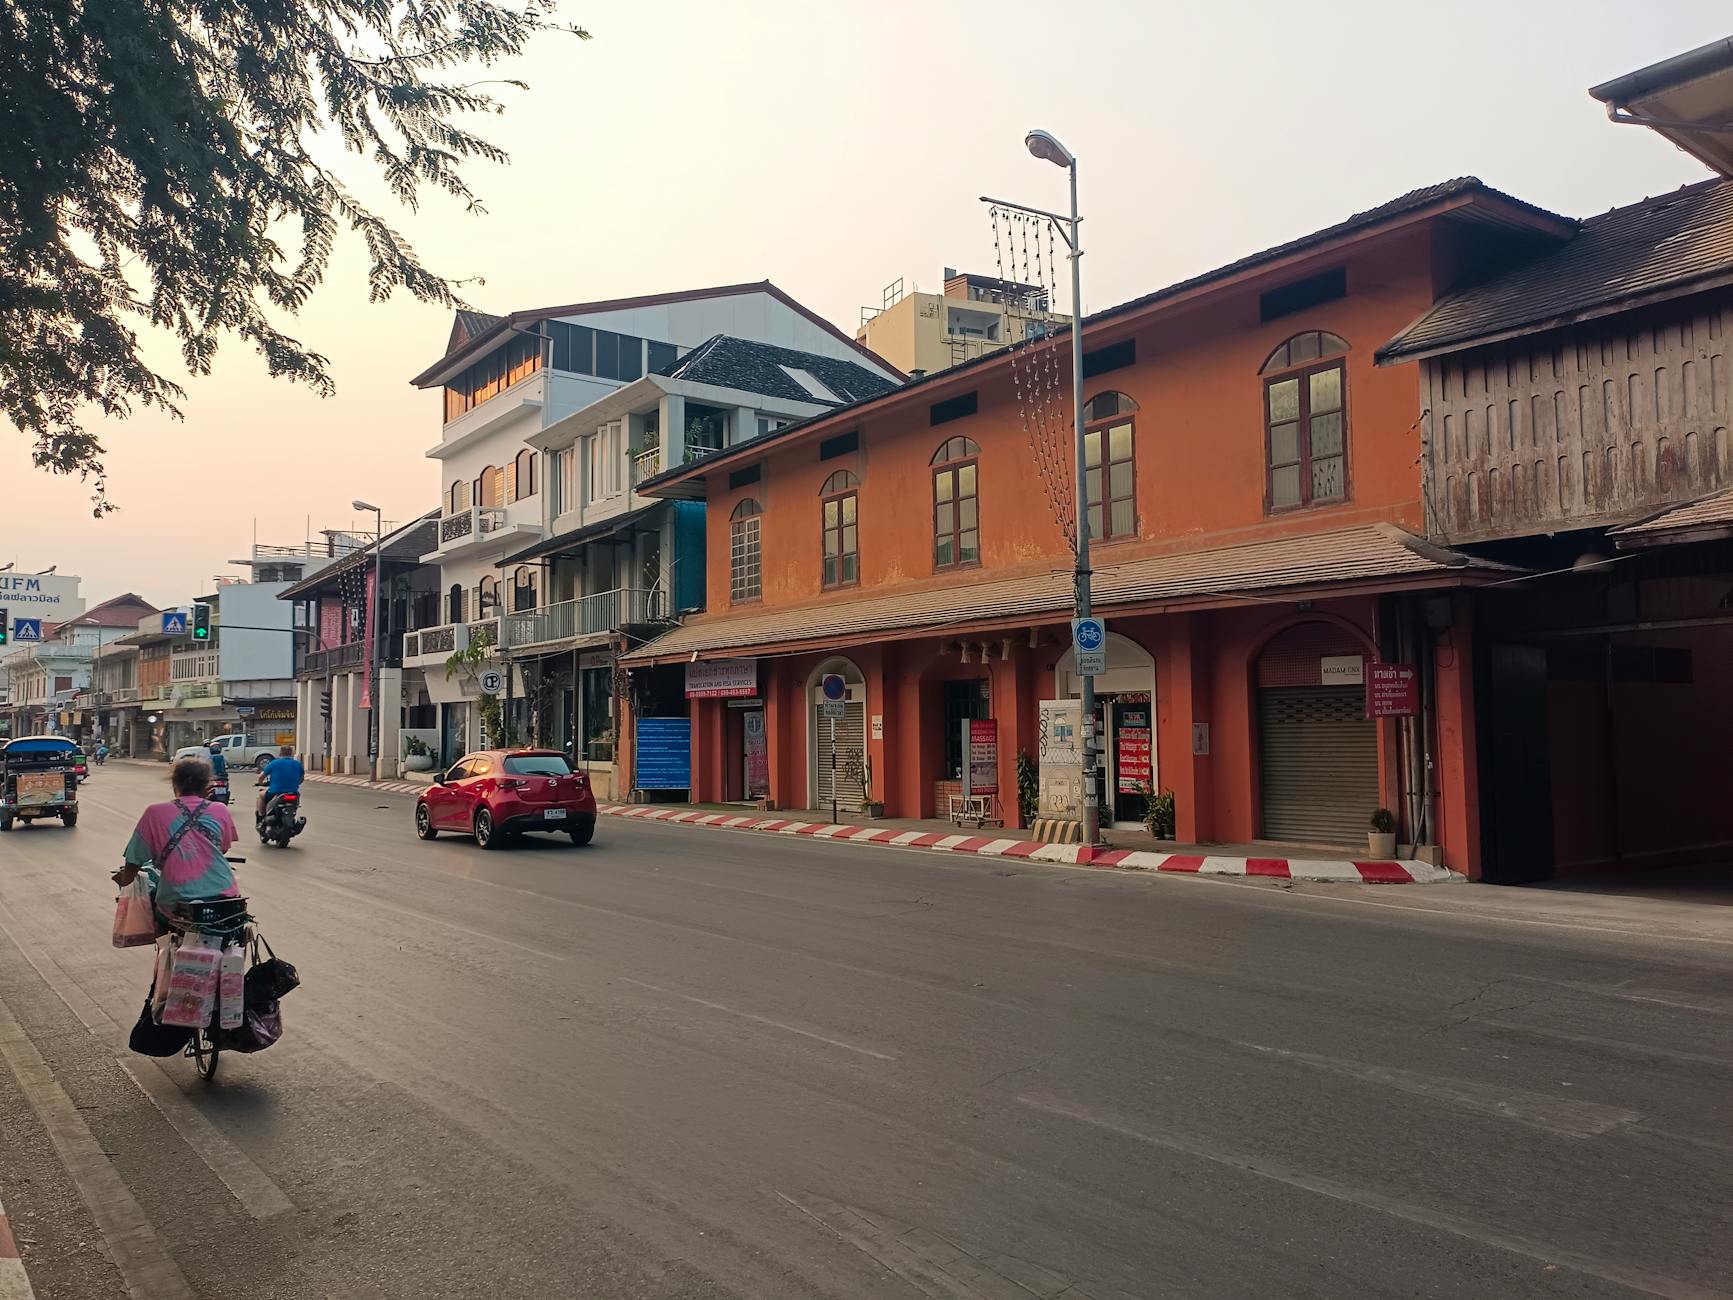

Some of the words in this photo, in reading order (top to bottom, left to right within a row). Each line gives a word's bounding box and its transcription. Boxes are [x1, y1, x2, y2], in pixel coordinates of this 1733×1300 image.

[1374, 666, 1397, 678] ทางเข้า
[971, 735, 996, 743] MASSAGE
